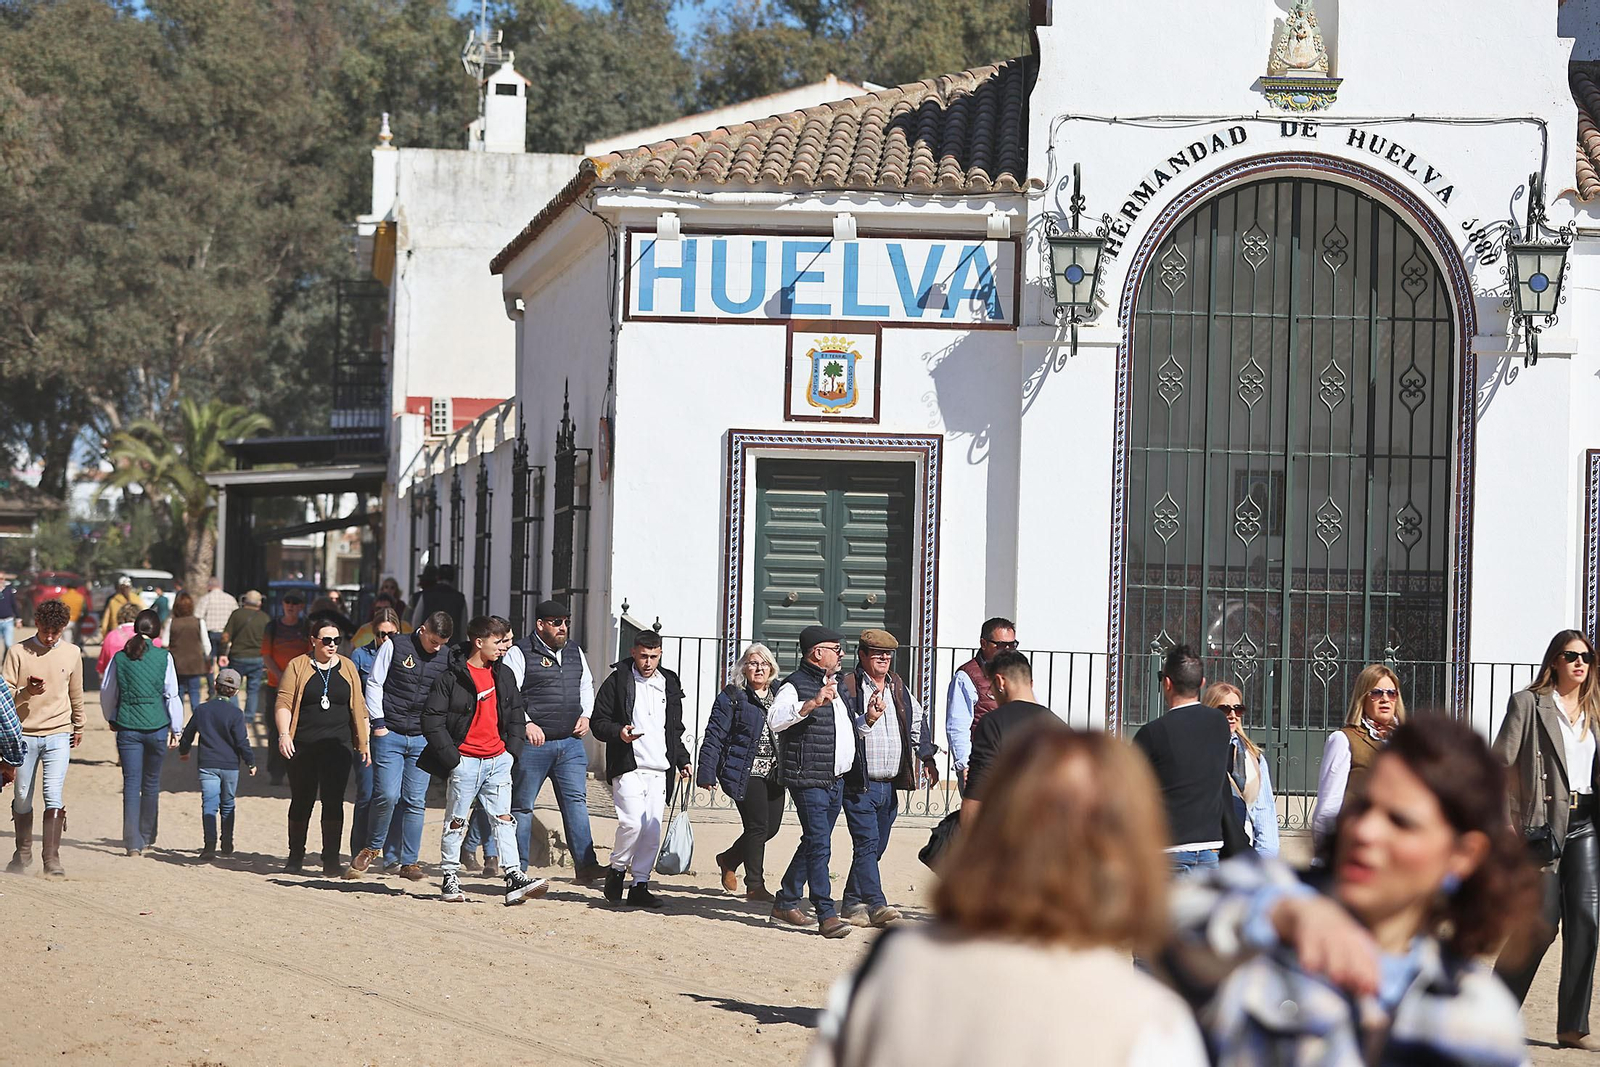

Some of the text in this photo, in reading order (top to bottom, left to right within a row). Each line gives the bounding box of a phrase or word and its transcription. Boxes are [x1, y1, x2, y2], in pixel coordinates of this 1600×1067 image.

[1105, 126, 1247, 258] HERMANDAD
[1281, 120, 1317, 138] DE
[1346, 128, 1455, 204] HUELVA
[638, 239, 1005, 320] HUELVA
